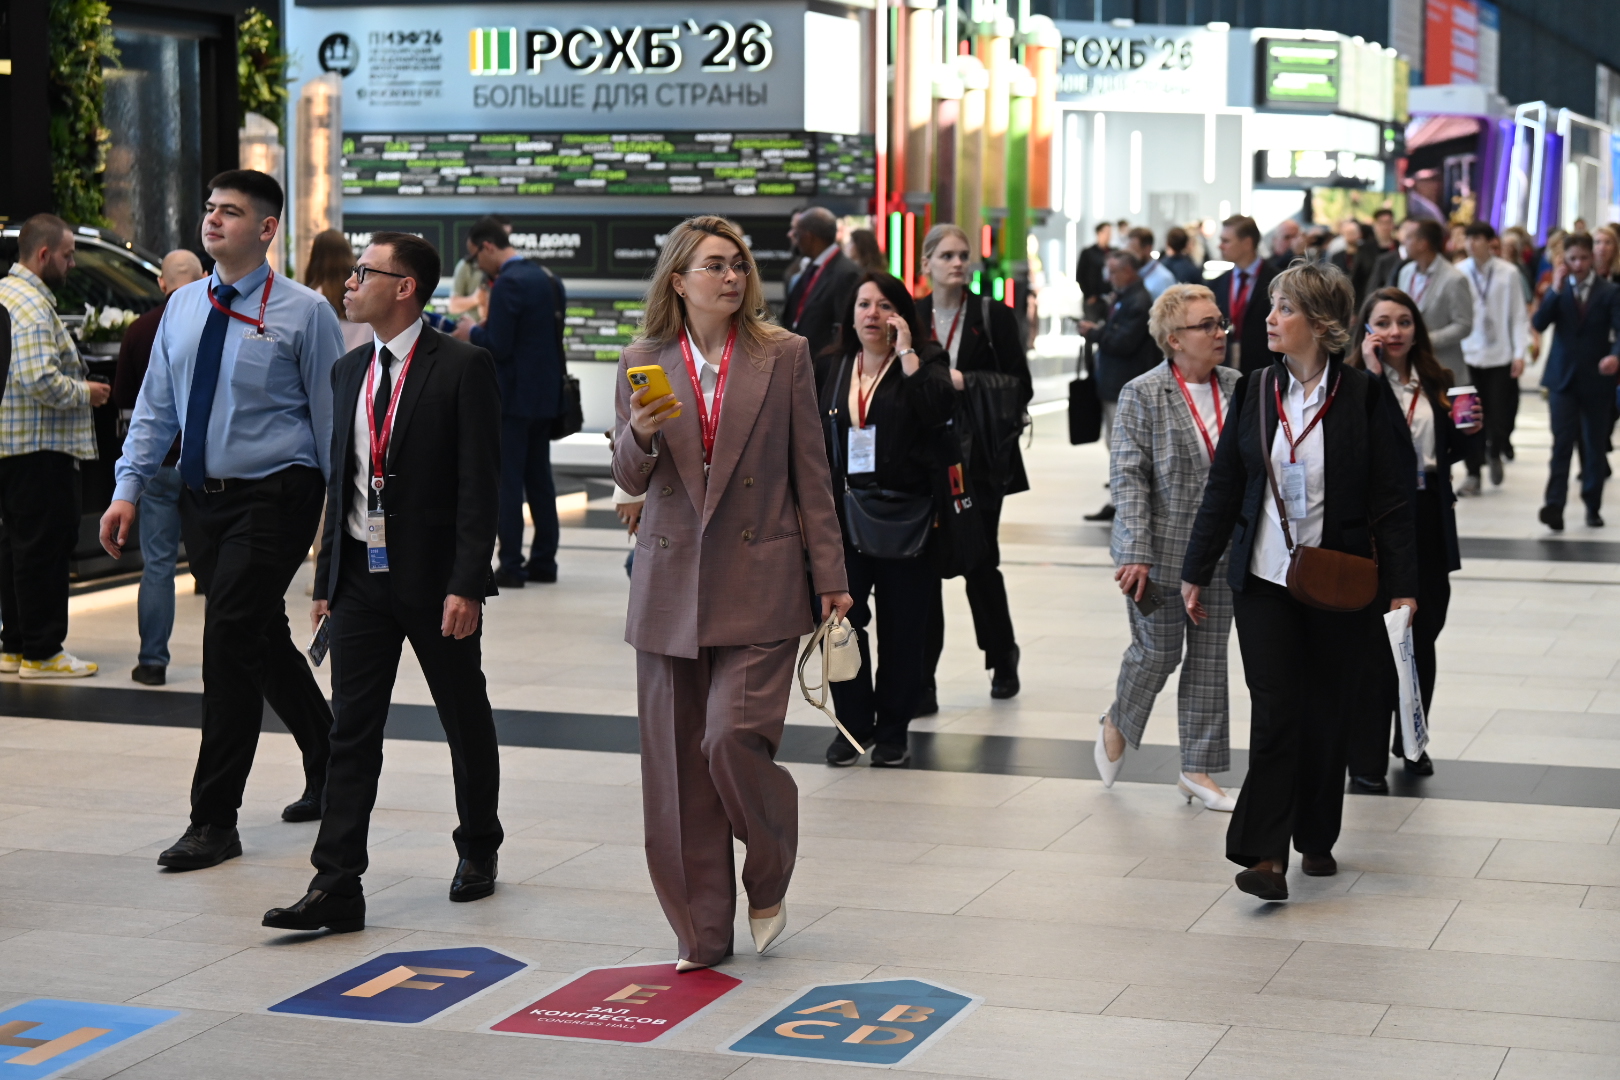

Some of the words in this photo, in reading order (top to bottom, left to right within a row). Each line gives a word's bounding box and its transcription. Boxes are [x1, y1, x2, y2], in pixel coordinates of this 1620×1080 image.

[472, 84, 587, 109] БОЛЬШЕ
[592, 84, 649, 113] ДЛЯ
[654, 82, 770, 109] СТРАНЫ
[340, 965, 475, 998] F
[603, 983, 672, 1005] E
[529, 1008, 668, 1026] КОНГРЕССОВ
[586, 1006, 631, 1015] ЗАЛ
[536, 1017, 602, 1027] CONGRESS
[606, 1021, 637, 1030] HALL
